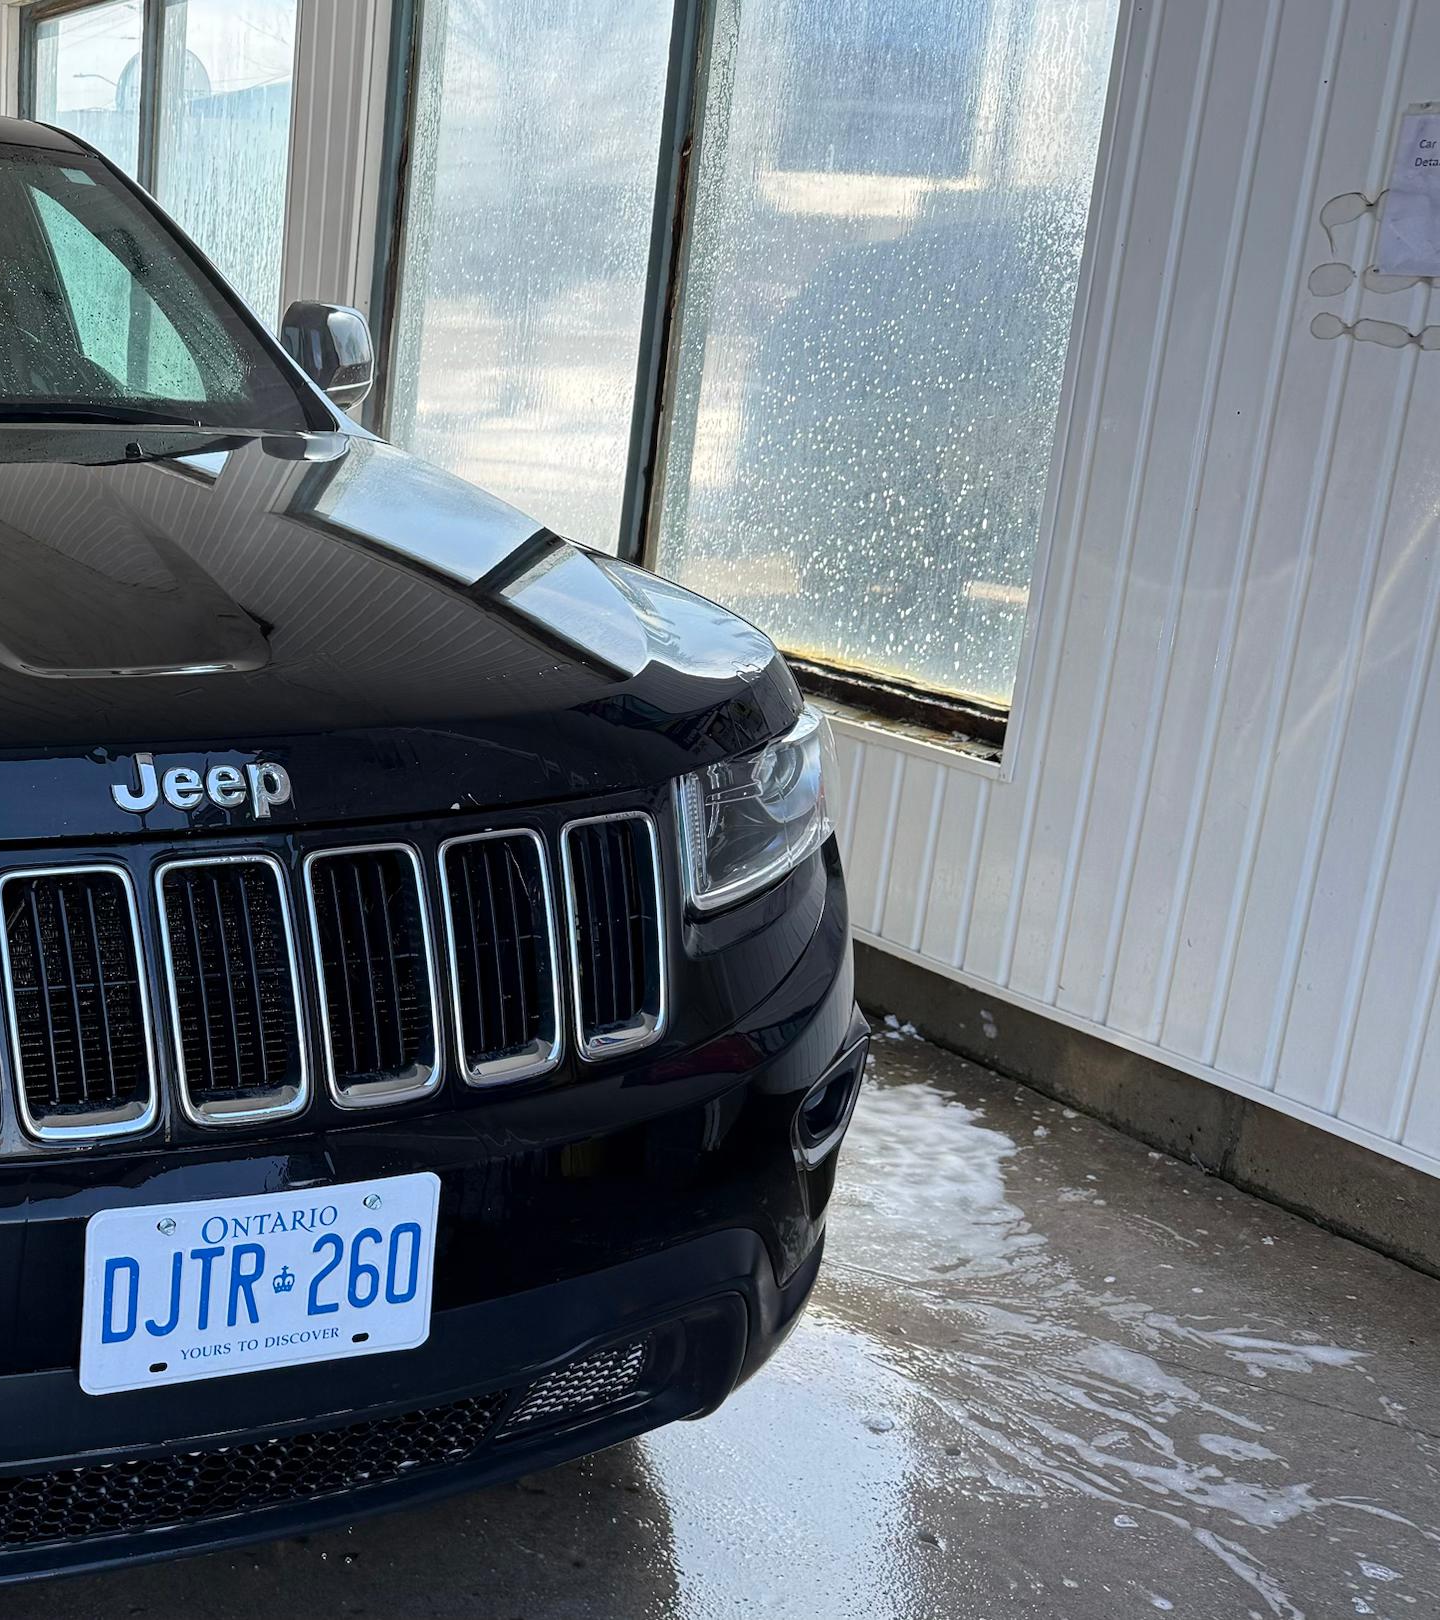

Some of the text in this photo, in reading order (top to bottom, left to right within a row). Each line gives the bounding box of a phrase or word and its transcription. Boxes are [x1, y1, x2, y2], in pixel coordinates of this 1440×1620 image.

[1414, 157, 1440, 167] Deta
[1419, 139, 1437, 149] Car
[111, 752, 291, 818] Jeep
[201, 1205, 338, 1244] ONTARIO
[101, 1222, 421, 1344] DJTR 260
[180, 1327, 339, 1360] YOURS TO DISCOVER
